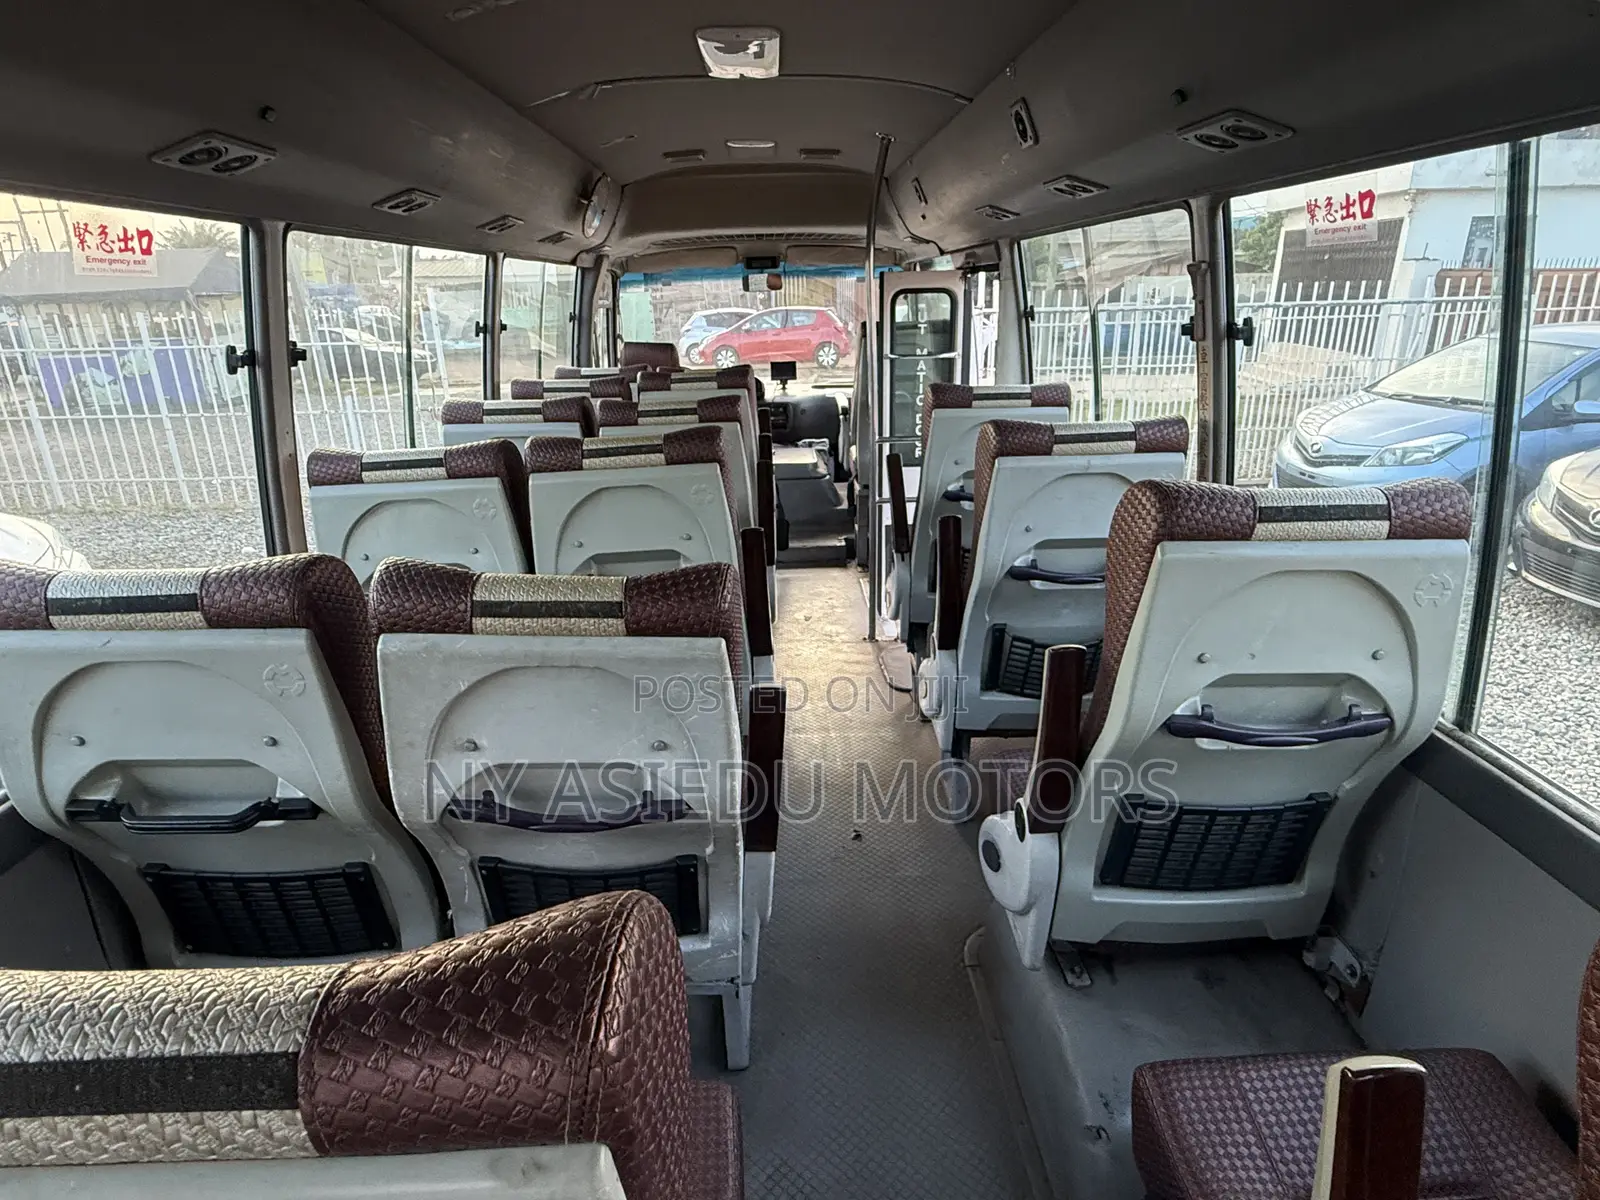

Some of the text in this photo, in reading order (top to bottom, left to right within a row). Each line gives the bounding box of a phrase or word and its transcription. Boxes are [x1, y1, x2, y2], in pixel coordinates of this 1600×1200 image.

[1306, 189, 1376, 226] 緊急出口
[72, 221, 153, 256] 緊急出口
[1314, 223, 1367, 235] Emergency exit
[85, 255, 131, 266] Emergency
